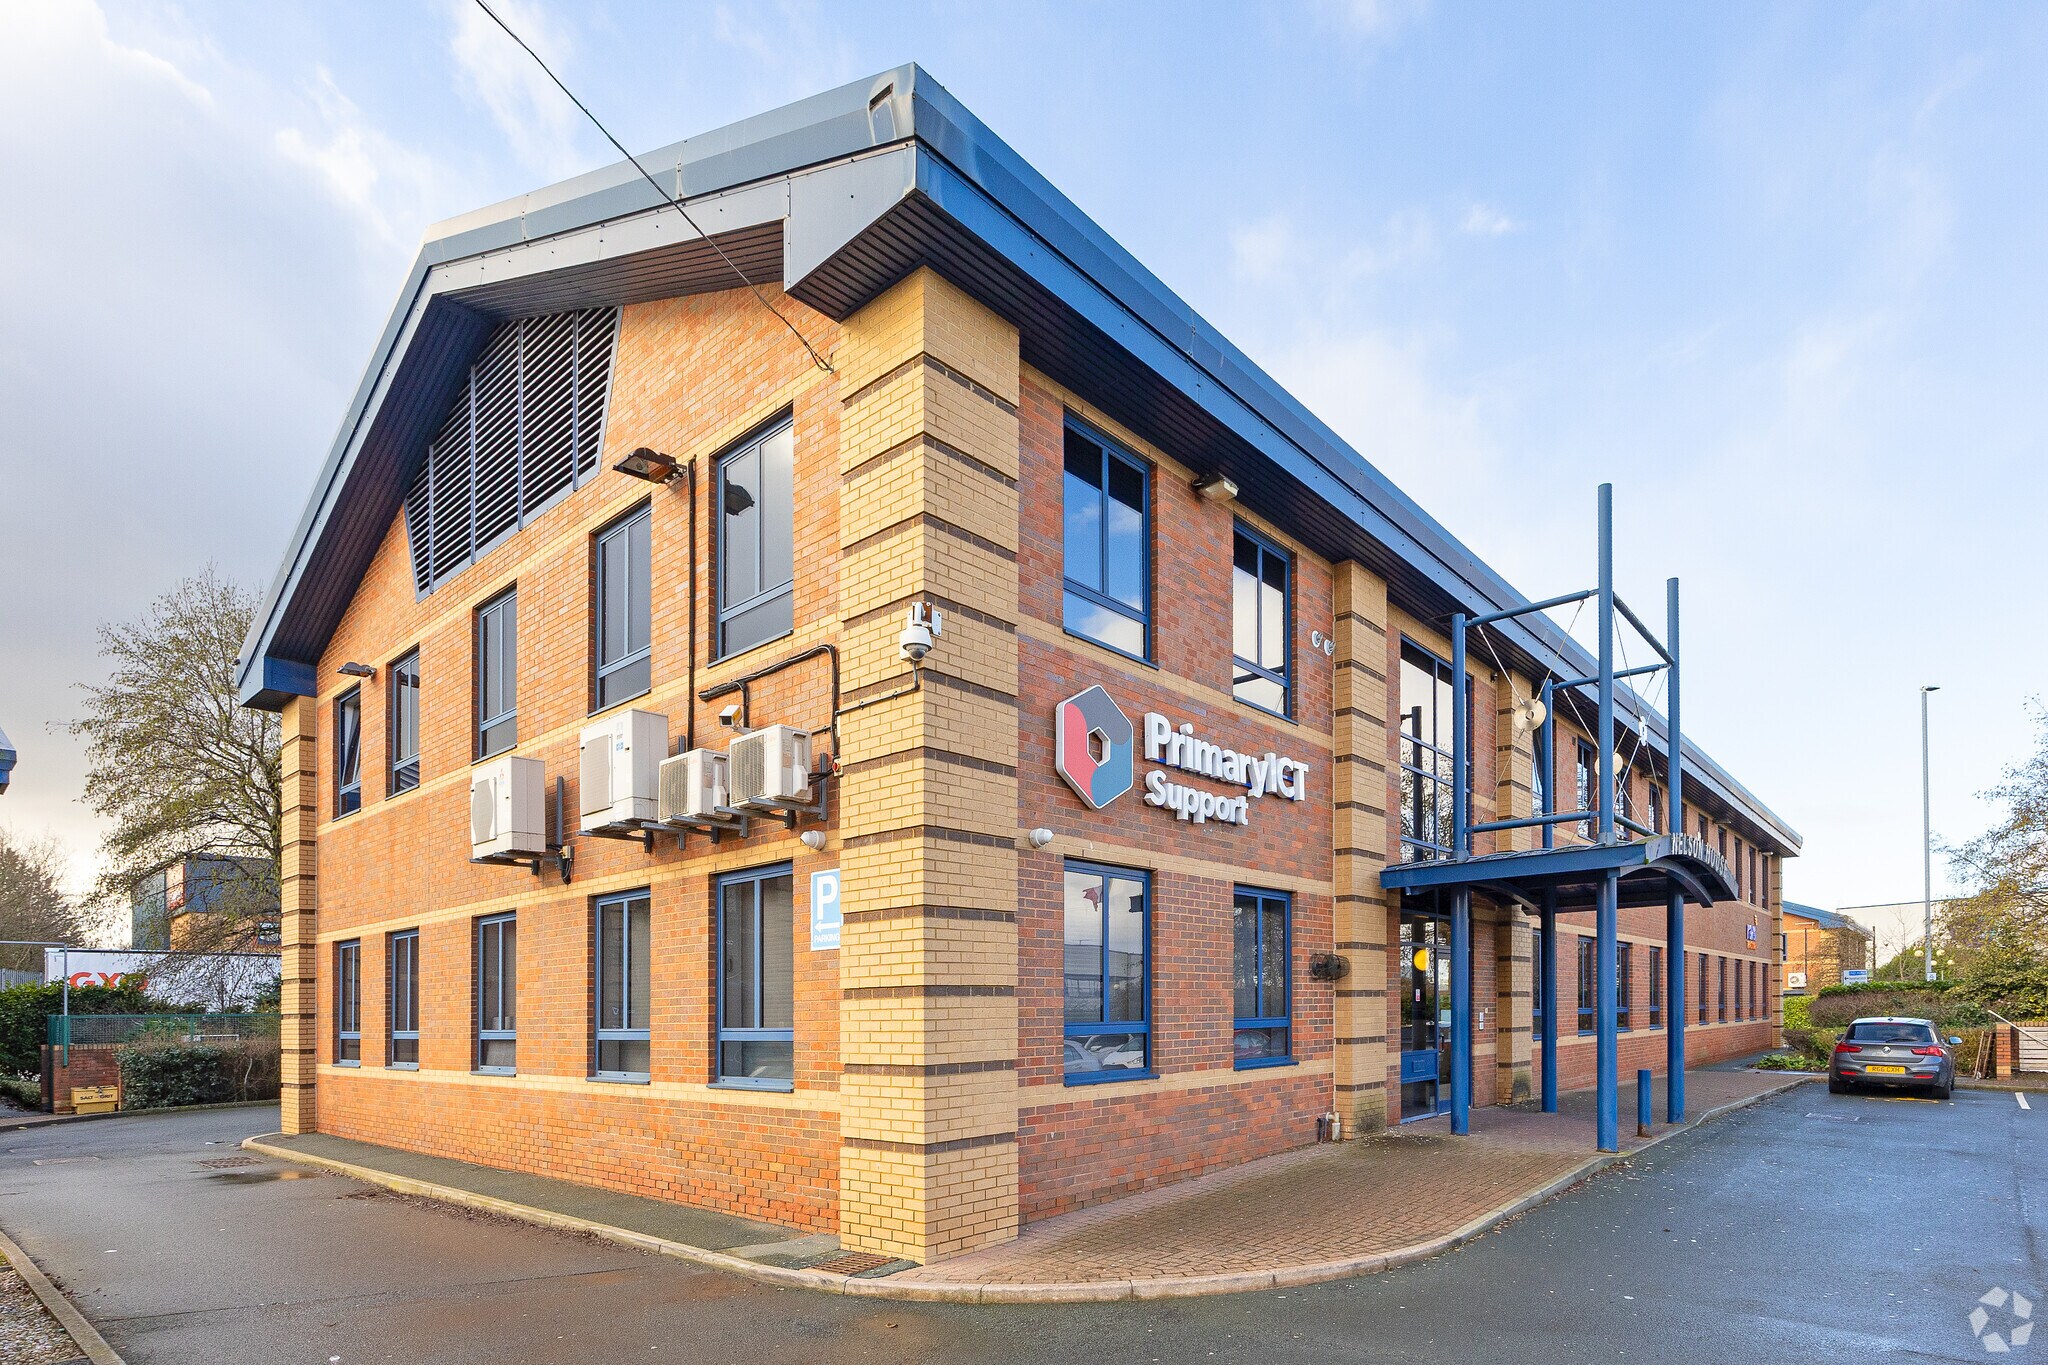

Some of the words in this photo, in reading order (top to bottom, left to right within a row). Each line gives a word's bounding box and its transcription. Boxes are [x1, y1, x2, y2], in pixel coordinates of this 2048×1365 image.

[1144, 712, 1309, 801] PrimaryICT
[1144, 770, 1249, 826] Support
[1671, 832, 1704, 860] NELSON
[817, 875, 838, 920] P
[814, 933, 840, 943] PARKING
